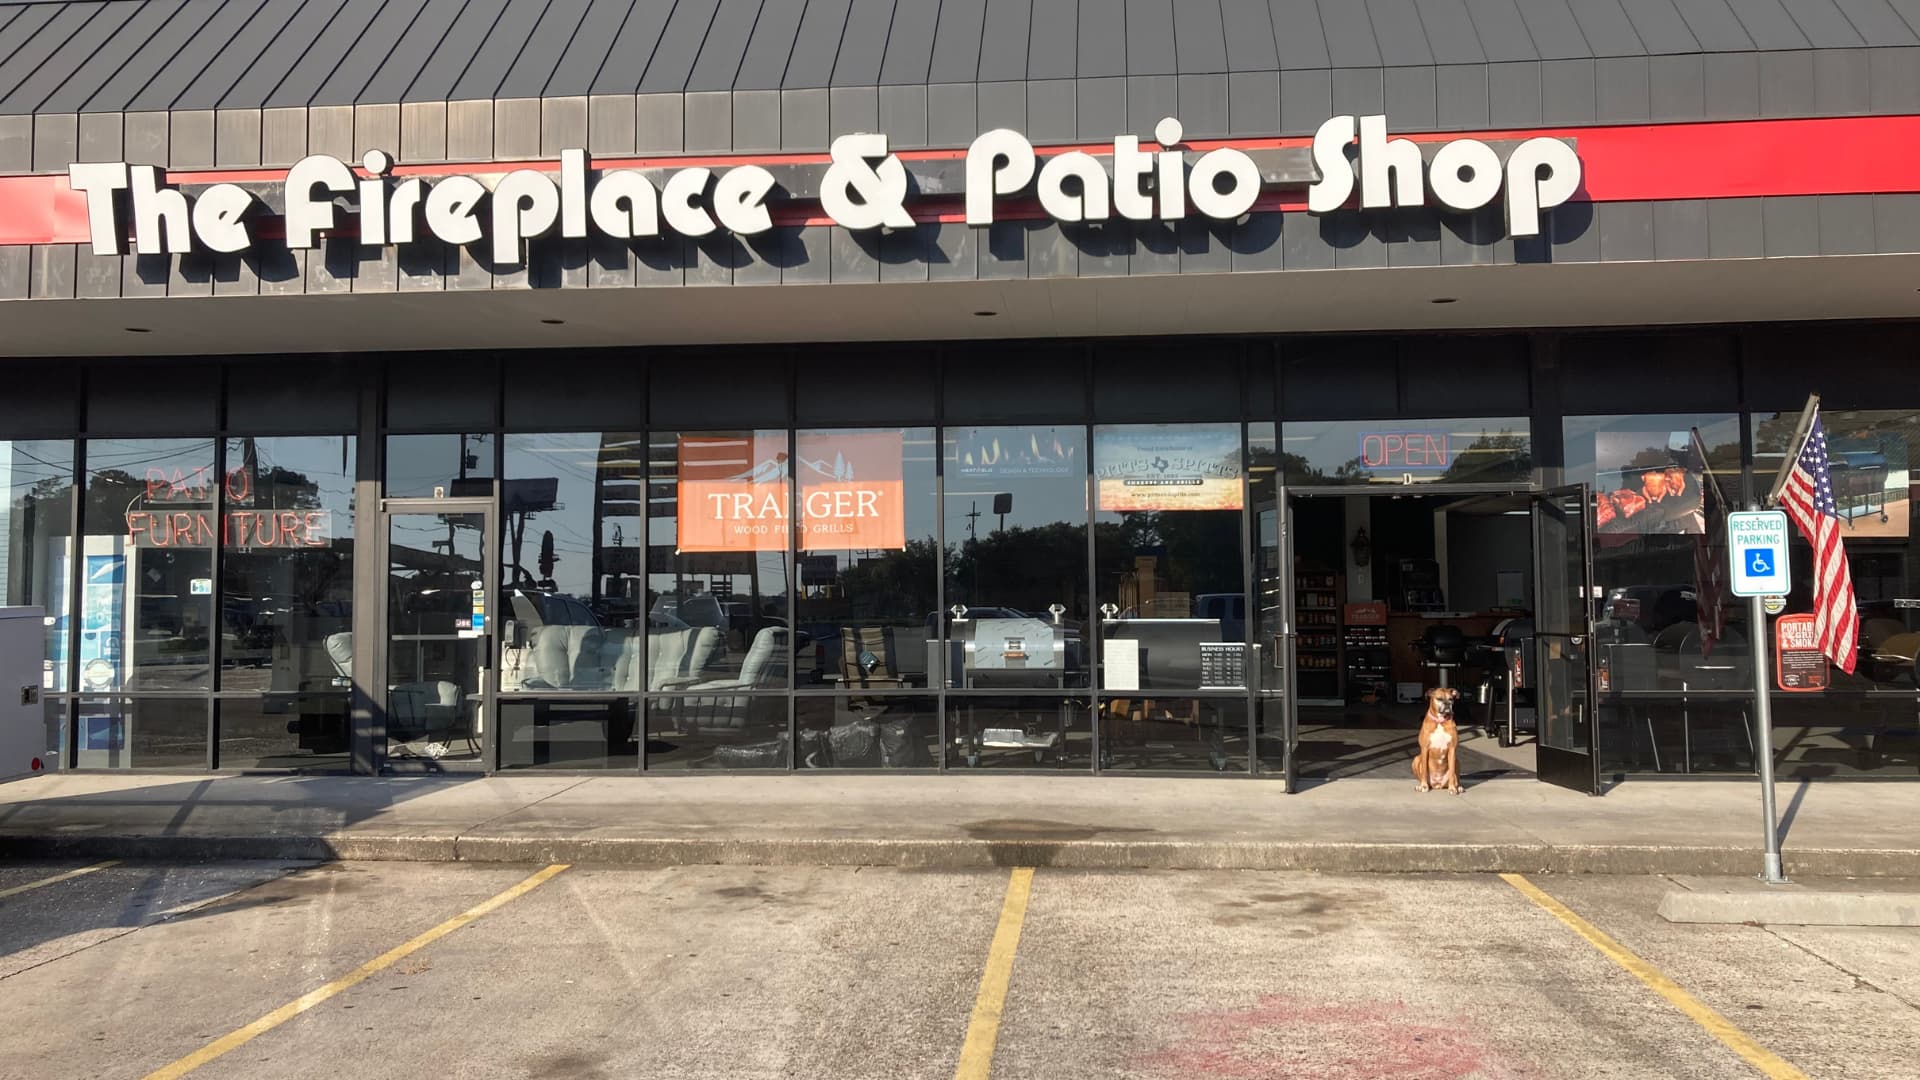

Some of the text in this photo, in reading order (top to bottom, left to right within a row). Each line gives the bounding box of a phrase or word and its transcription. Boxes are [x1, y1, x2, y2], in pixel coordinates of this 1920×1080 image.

[69, 114, 1581, 263] The Fireplace & Patio Shop
[1362, 433, 1447, 467] OPEN
[145, 467, 248, 500] PATO
[1402, 472, 1413, 485] D
[734, 524, 768, 535] WOOD
[813, 523, 854, 534] GRILLS
[1733, 519, 1783, 532] RESERVED
[1737, 533, 1781, 545] PARKING
[1781, 621, 1815, 632] PORTAB
